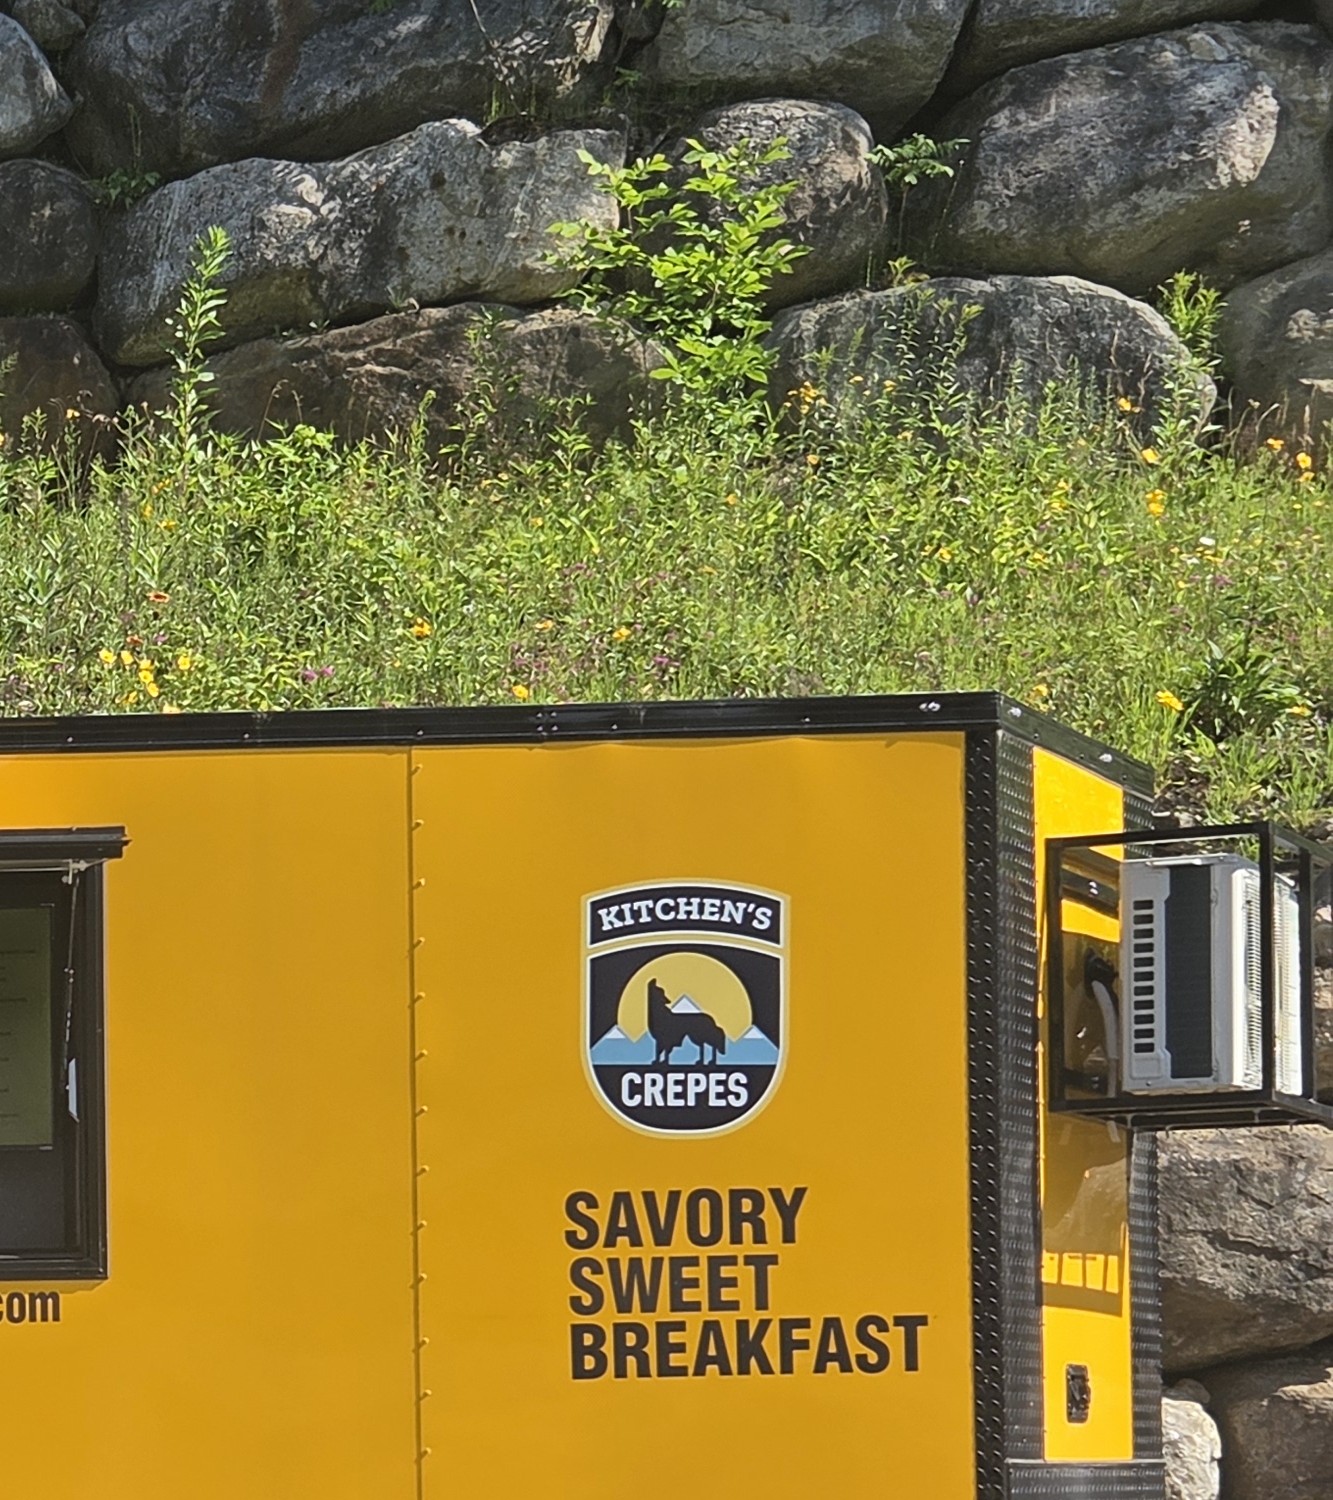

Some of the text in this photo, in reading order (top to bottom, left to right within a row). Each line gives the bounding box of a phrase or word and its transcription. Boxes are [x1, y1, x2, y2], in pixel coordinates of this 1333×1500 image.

[597, 896, 773, 932] KITCHEN'S
[619, 1071, 749, 1109] CREPES
[563, 1186, 809, 1251] SAVORY
[567, 1253, 779, 1316] SWEET
[569, 1314, 929, 1381] BREAKFAST
